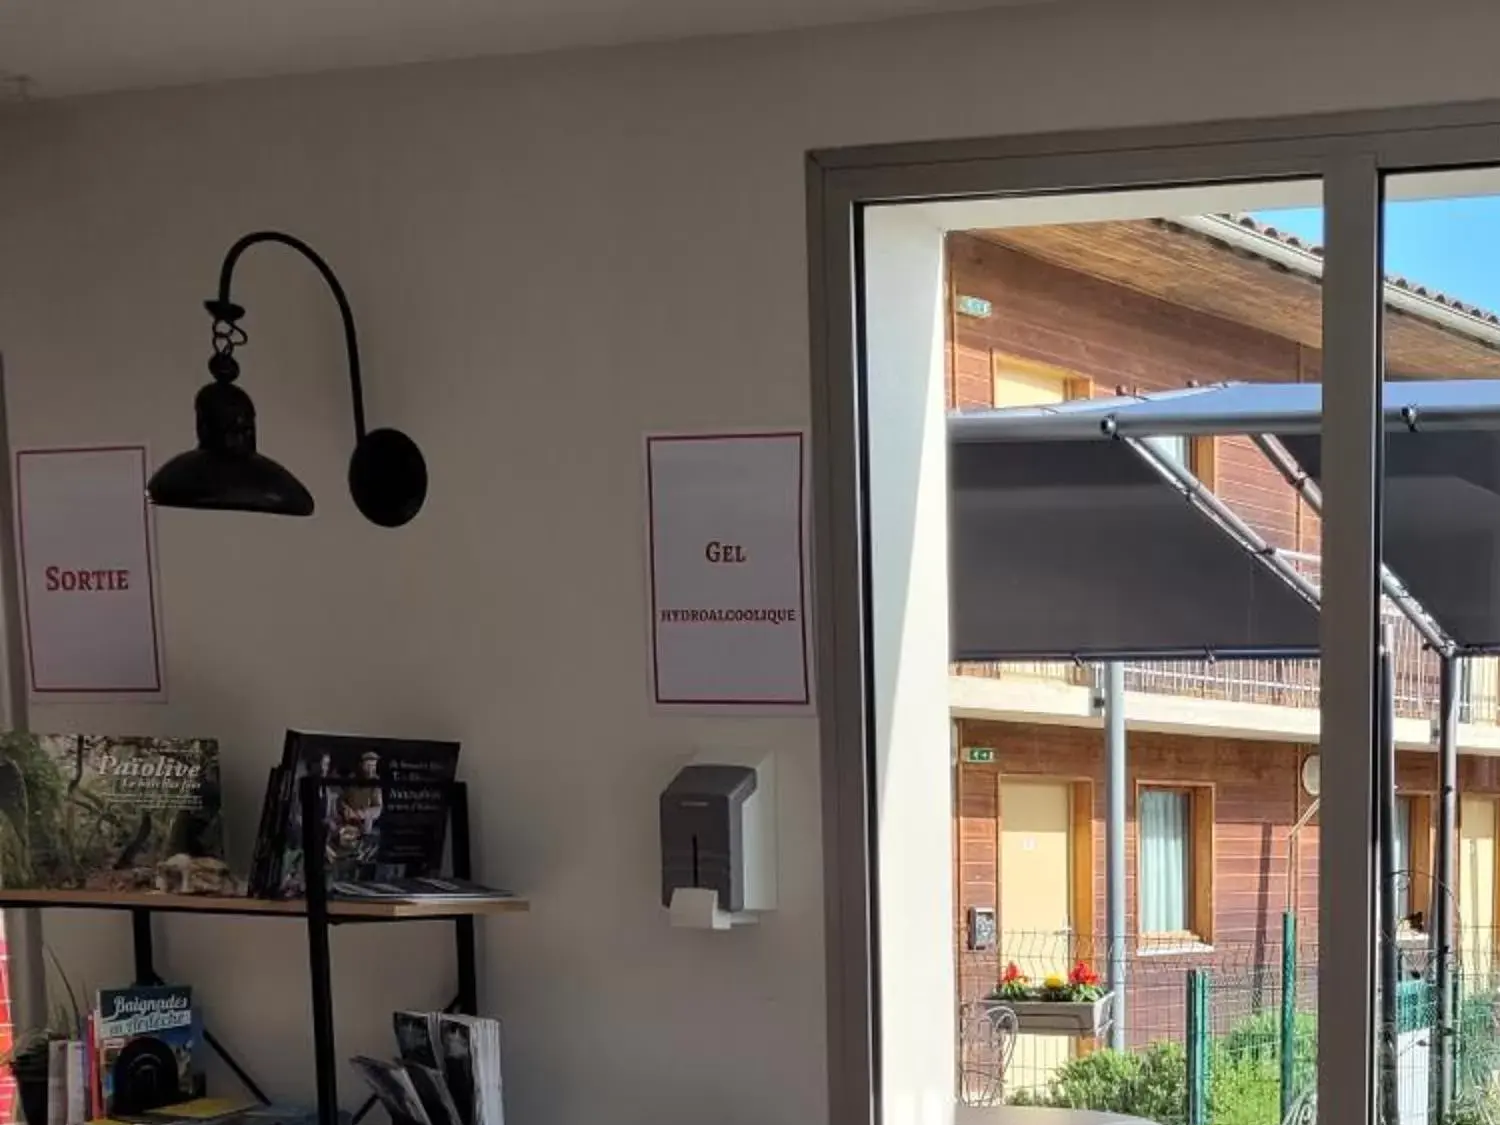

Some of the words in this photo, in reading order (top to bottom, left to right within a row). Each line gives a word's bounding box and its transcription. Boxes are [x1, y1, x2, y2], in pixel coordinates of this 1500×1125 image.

[704, 541, 747, 563] GEL
[45, 565, 130, 592] SORTIE
[660, 608, 797, 625] HYDROALCOOLIQUE
[98, 754, 201, 777] Païolive
[113, 993, 188, 1018] Baignades
